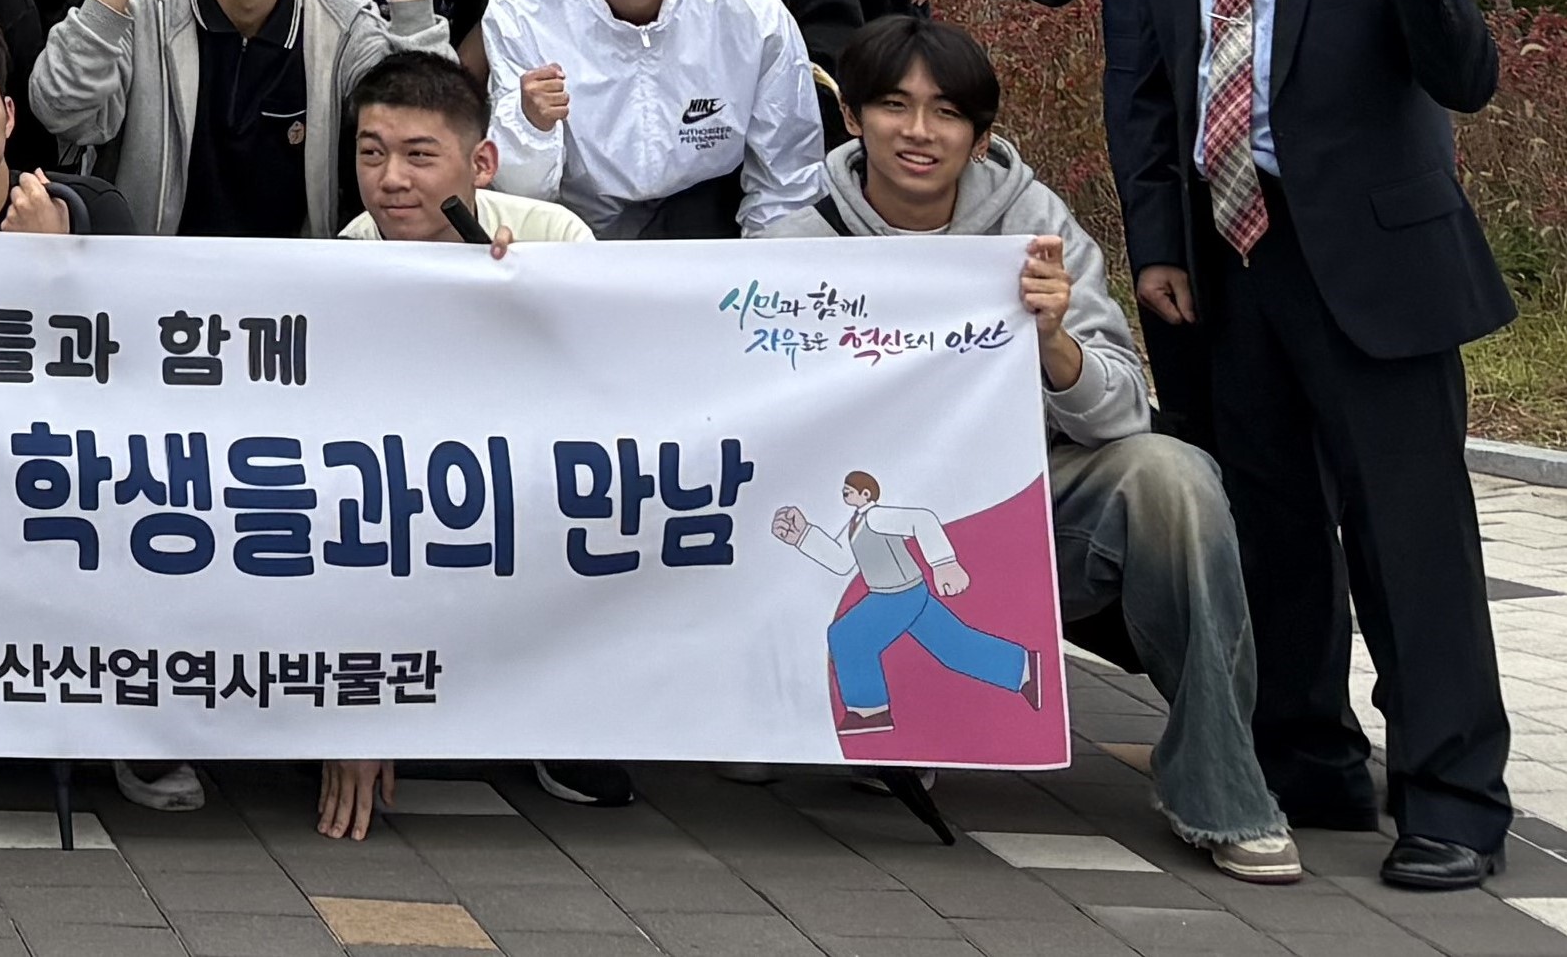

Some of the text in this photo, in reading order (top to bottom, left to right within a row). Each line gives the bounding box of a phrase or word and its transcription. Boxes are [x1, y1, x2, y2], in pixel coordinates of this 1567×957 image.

[688, 97, 721, 113] NIKE
[719, 280, 806, 330] 시민과
[157, 309, 308, 386] 함께
[839, 326, 934, 366] 혁신도시
[945, 320, 1014, 354] 안산
[10, 421, 515, 578] 학생들과의
[553, 438, 755, 578] 만남
